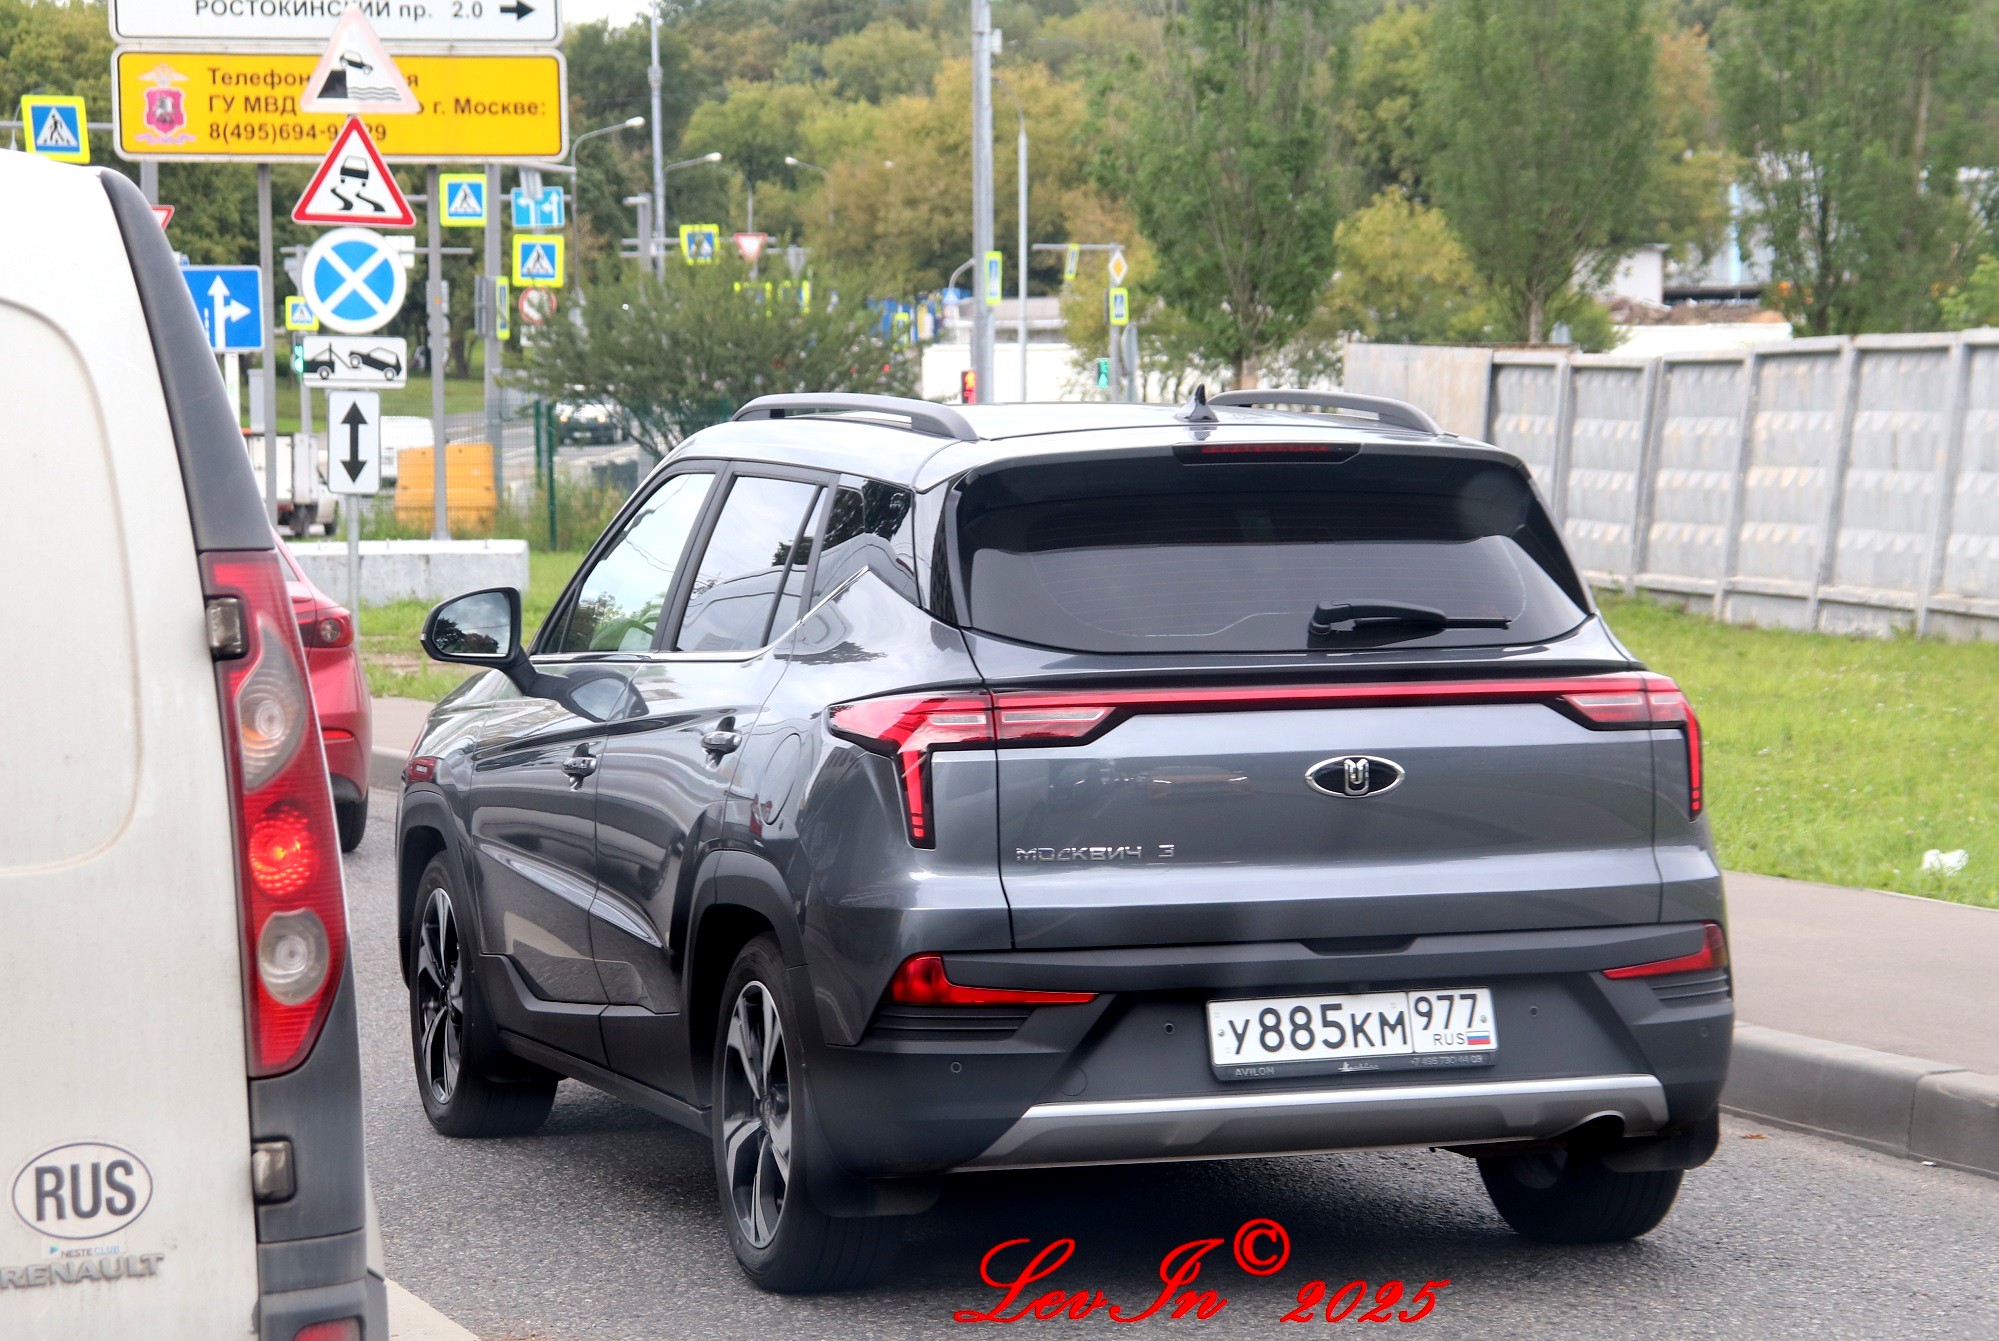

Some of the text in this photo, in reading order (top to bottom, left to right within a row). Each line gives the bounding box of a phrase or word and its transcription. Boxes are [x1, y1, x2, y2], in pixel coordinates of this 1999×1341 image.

[399, 6, 433, 22] пр.
[452, 1, 483, 18] 2.0
[208, 95, 236, 113] ГУ
[243, 95, 297, 116] МВД
[432, 101, 446, 115] г.
[454, 97, 547, 116] Москве:
[1015, 844, 1175, 862] МОСКВИЧ 3
[1413, 992, 1478, 1031] 977
[1227, 1002, 1408, 1055] У885КМ
[1432, 1031, 1466, 1046] RUS
[1234, 1066, 1275, 1078] AVILON
[34, 1159, 137, 1222] RUS
[60, 1244, 120, 1259] NESTE CLUB
[0, 1252, 165, 1291] RENAULT
